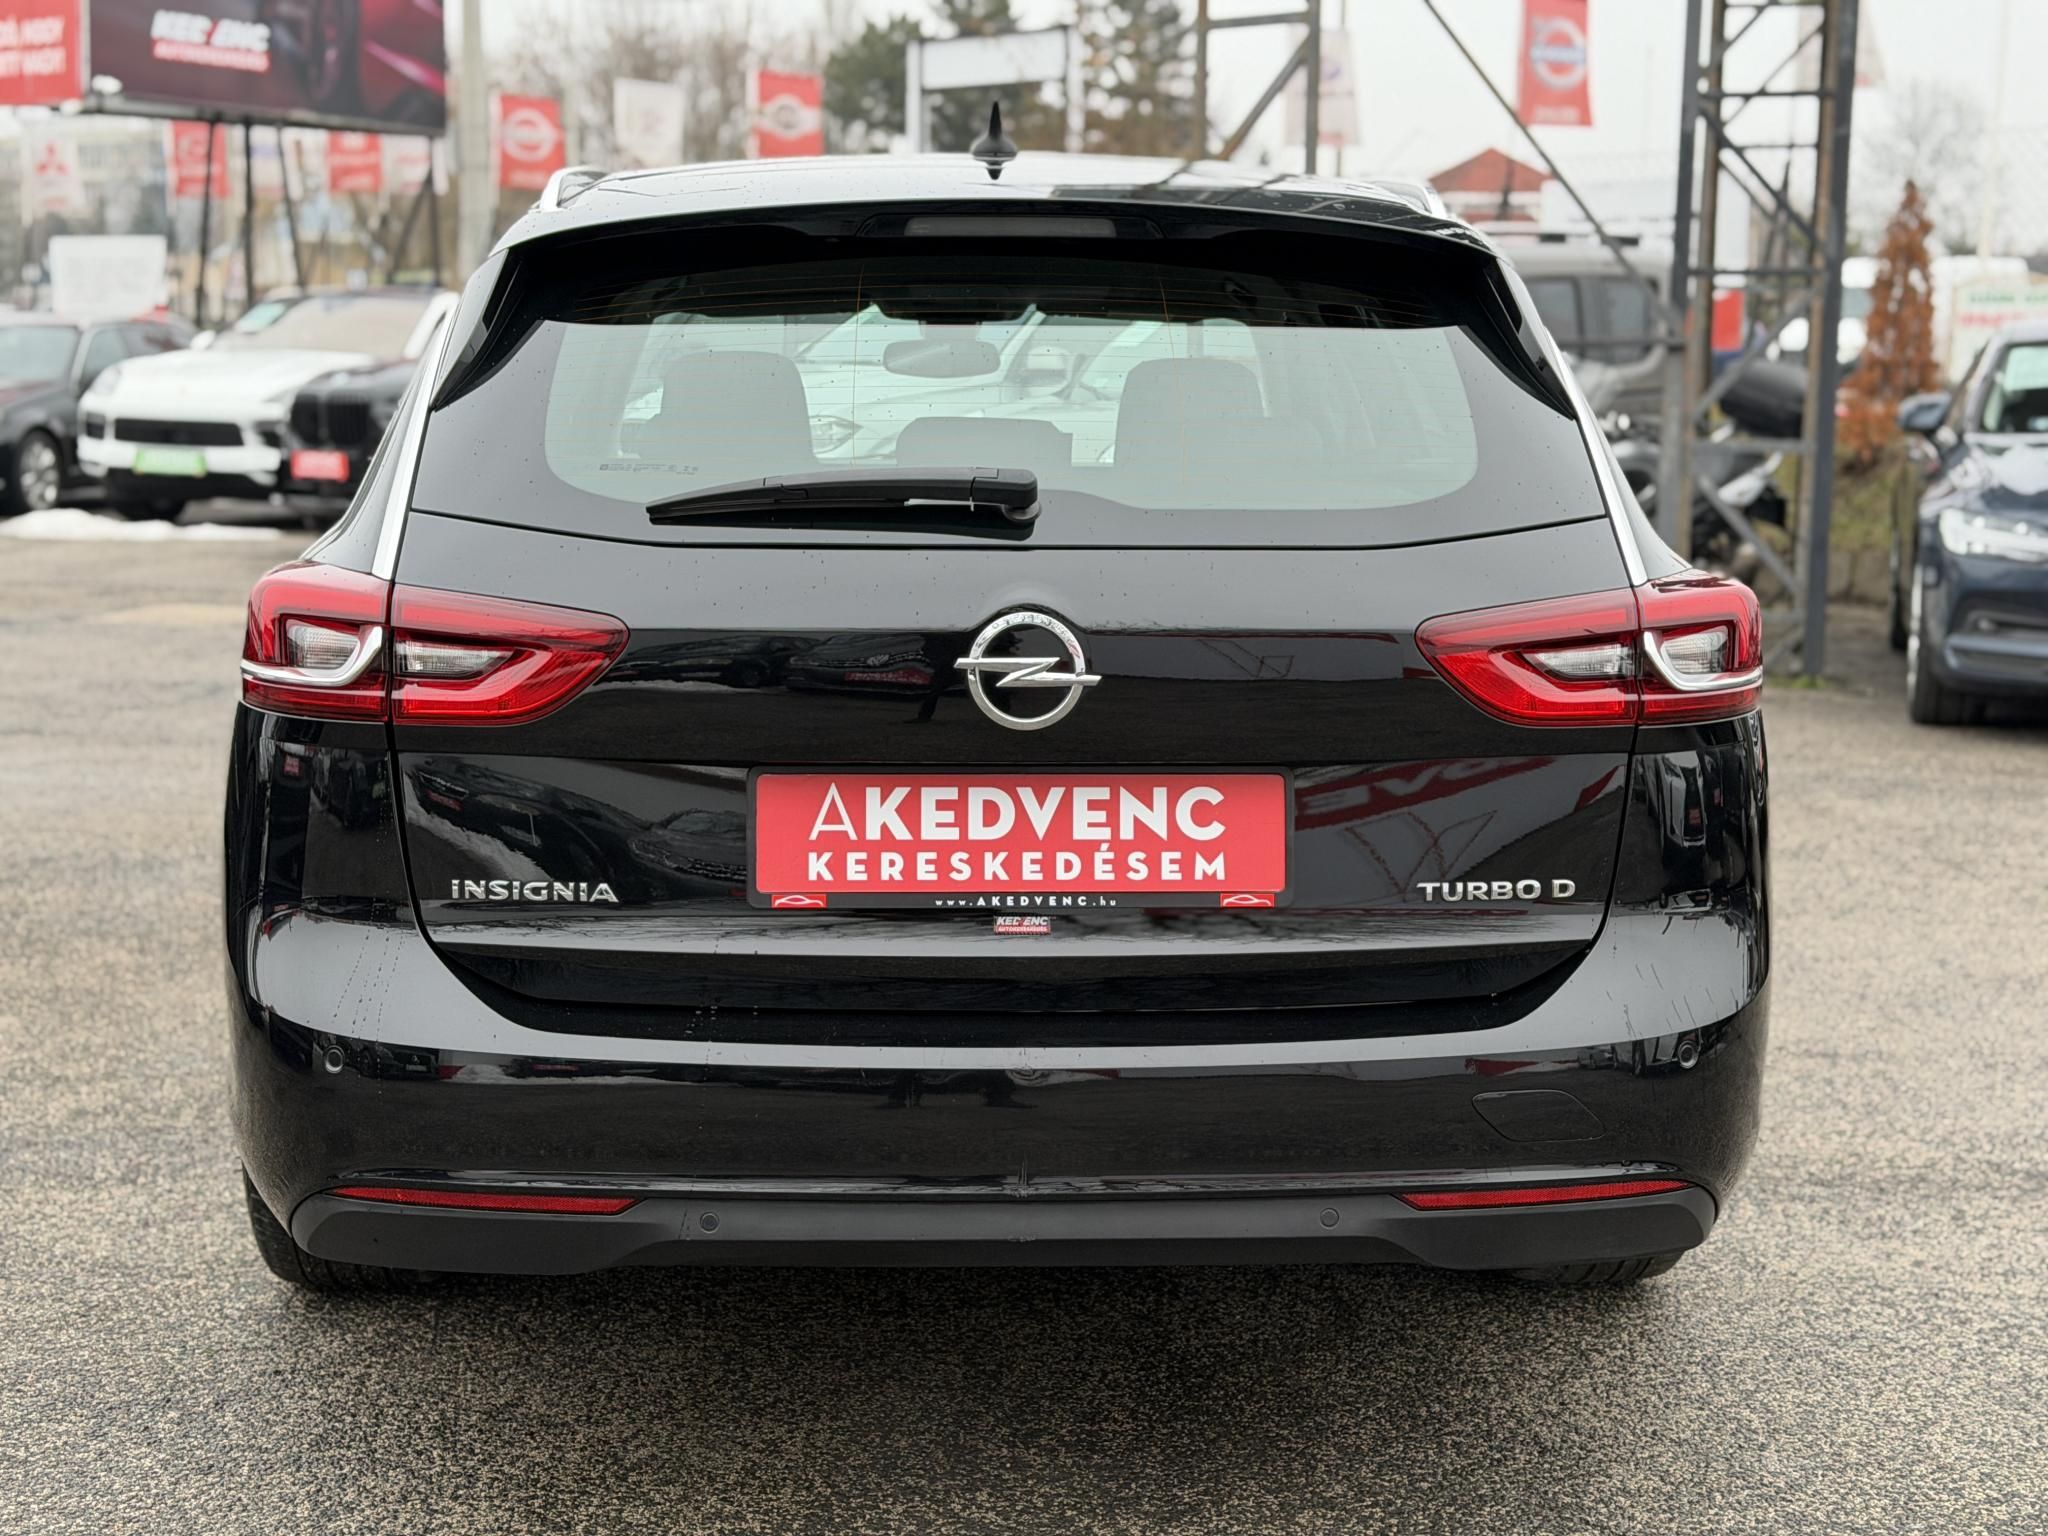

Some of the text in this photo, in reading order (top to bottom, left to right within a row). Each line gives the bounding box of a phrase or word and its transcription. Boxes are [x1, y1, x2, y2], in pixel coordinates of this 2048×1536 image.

[808, 843, 1226, 881] KERESKEDÉSEM
[451, 879, 619, 903] INSIGNIA
[935, 896, 1117, 906] www.AKEDVENC.hu
[1416, 879, 1576, 902] TURBO D
